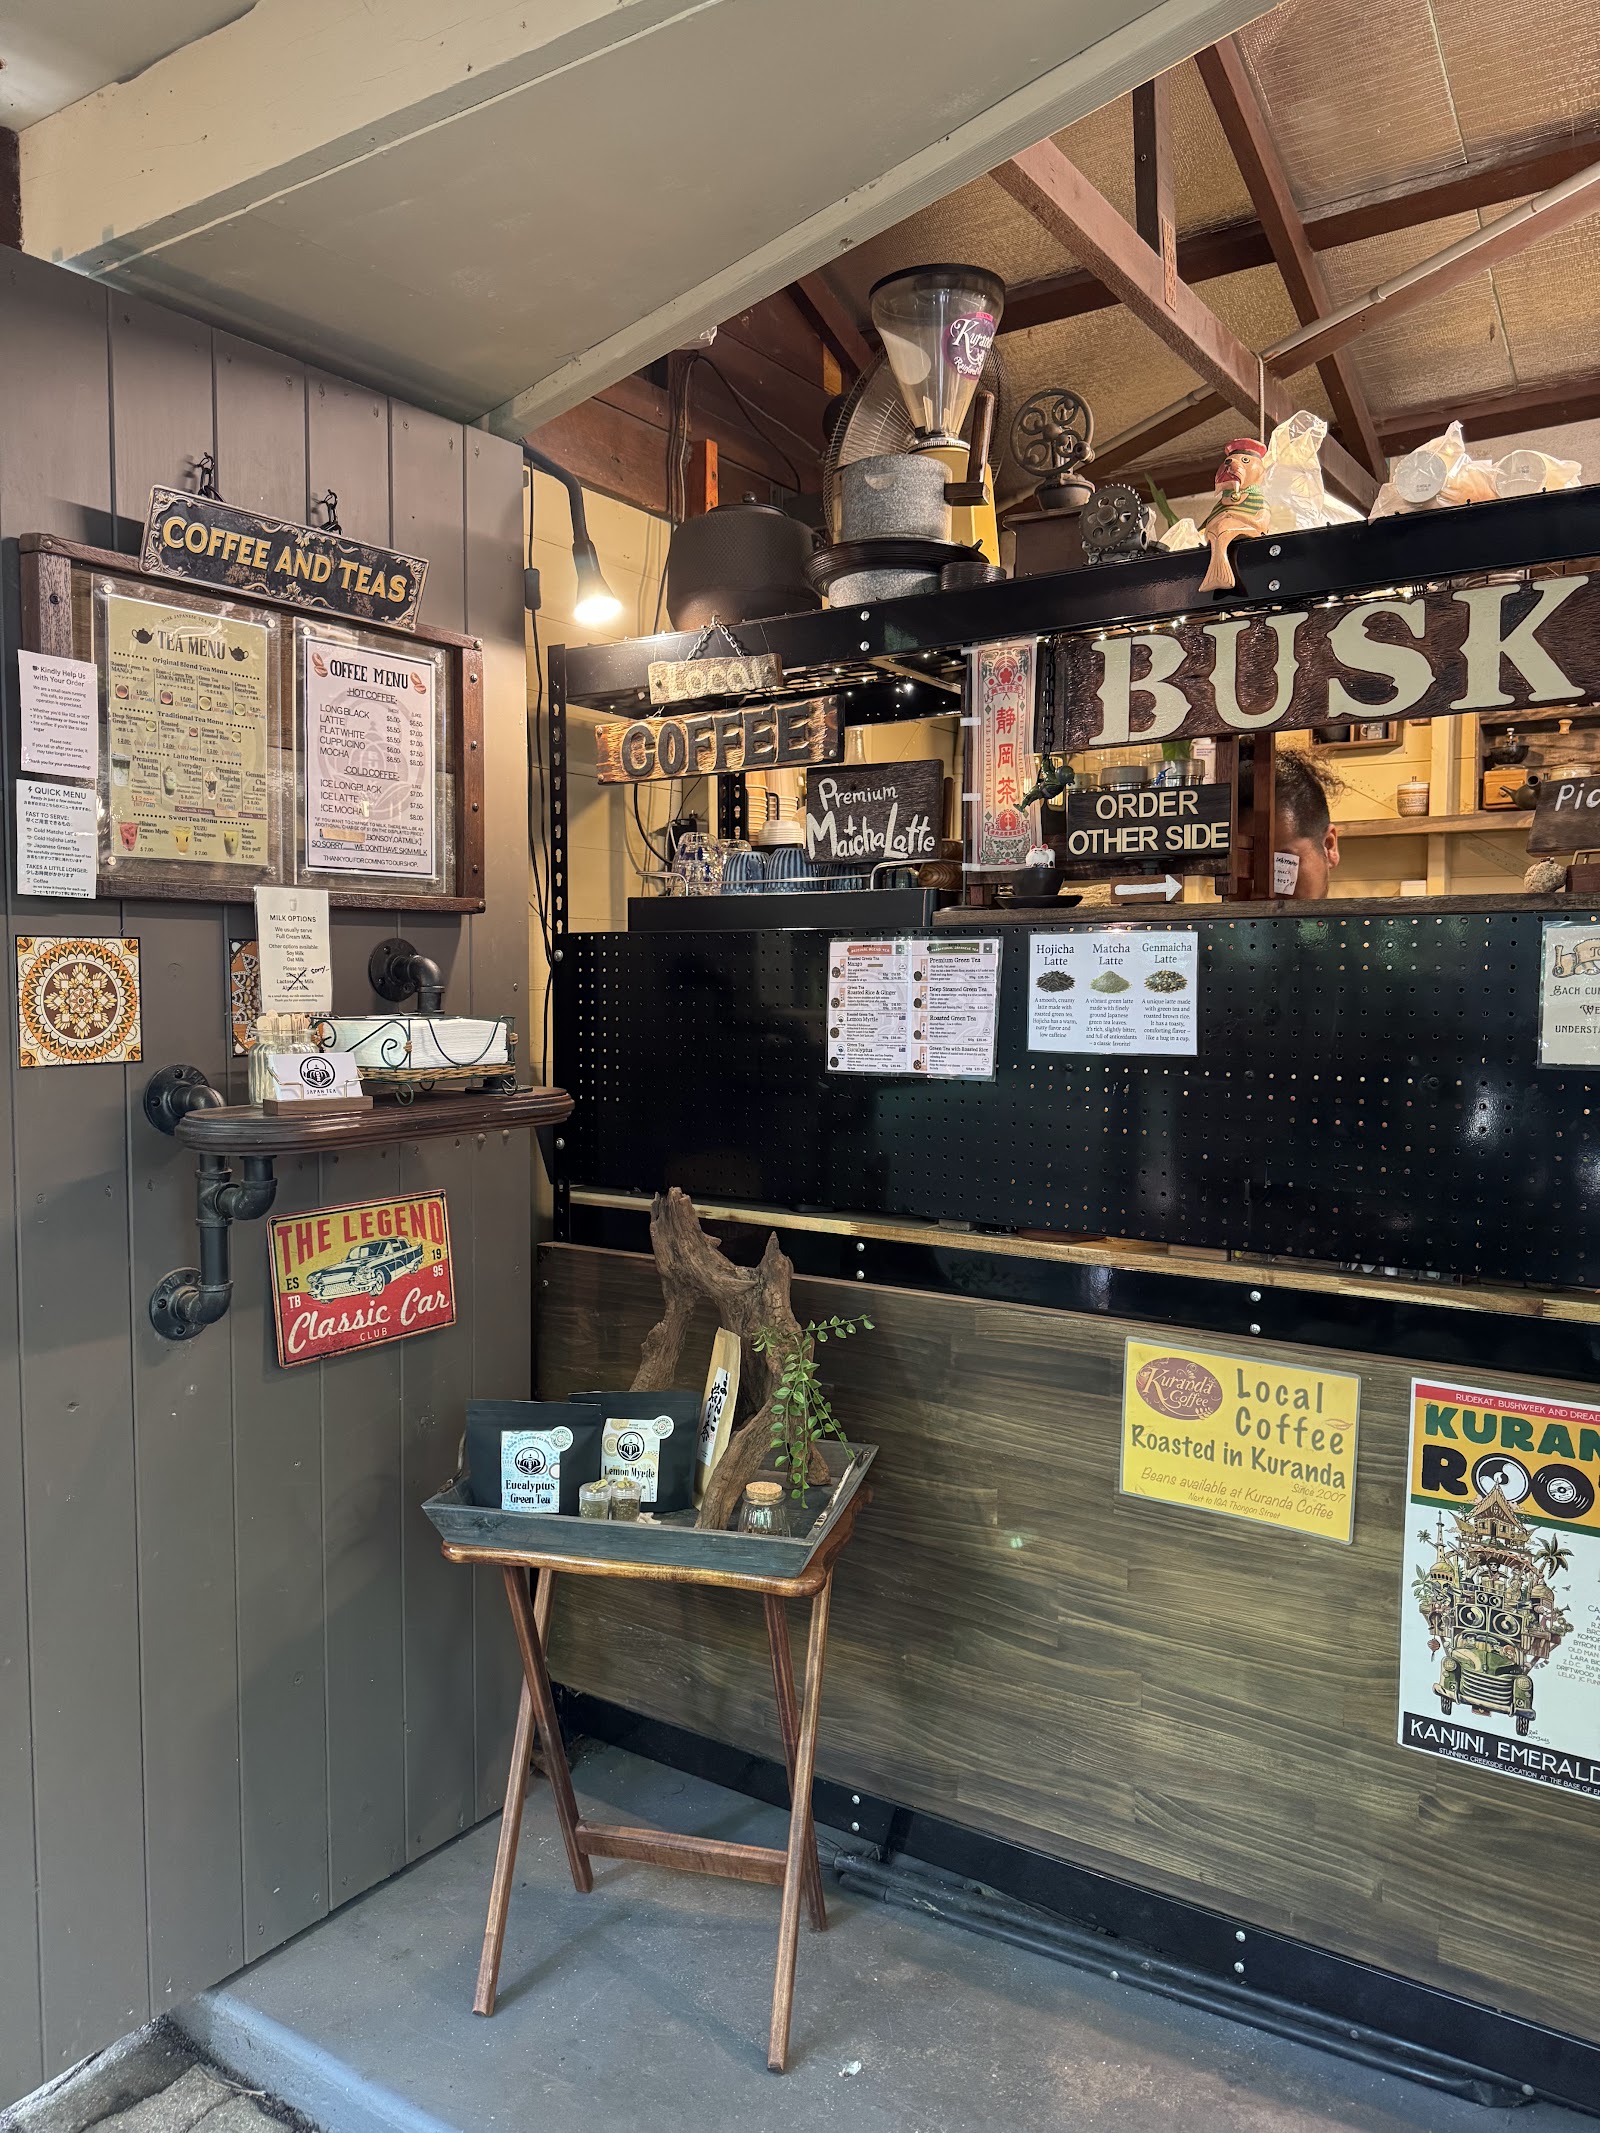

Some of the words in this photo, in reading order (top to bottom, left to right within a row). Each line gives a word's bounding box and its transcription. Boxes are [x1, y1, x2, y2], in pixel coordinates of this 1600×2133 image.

[162, 516, 271, 569] COFFEE
[274, 546, 332, 584] AND
[338, 557, 407, 603] TEAS
[158, 630, 184, 653] TEA
[188, 637, 226, 660] MENU
[152, 657, 179, 667] Original
[180, 662, 198, 670] Blend
[210, 667, 228, 675] Menu
[1089, 574, 1589, 747] BUSK
[40, 667, 61, 676] Kindly
[62, 670, 77, 678] Help
[330, 660, 367, 682] COFFEE
[373, 668, 408, 689] MENU
[34, 674, 49, 682] with
[66, 679, 84, 687] Order
[158, 711, 193, 722] Traditional
[320, 704, 343, 714] LONG
[344, 708, 370, 719] BLACK
[320, 715, 345, 725] LATTE
[320, 725, 341, 736] FLAT
[341, 728, 365, 740] WHITE
[320, 736, 366, 750] CUPPUCINO
[622, 703, 812, 777] COFFEE
[320, 747, 349, 758] MOCHA
[996, 706, 1016, 805] 静岡茶
[35, 787, 61, 796] QUICK
[63, 790, 86, 799] MENU
[321, 792, 334, 801] ICE
[335, 793, 359, 803] LATTE
[818, 777, 898, 811] Premium
[335, 806, 364, 815] MOCHA
[1096, 790, 1199, 820] ORDER
[1068, 825, 1158, 855] OTHER
[1165, 822, 1230, 850] SIDE
[1036, 944, 1075, 956] Hojicha
[1092, 944, 1130, 953] Matcha
[1142, 943, 1192, 952] Genmaicha
[1044, 956, 1068, 965] Latte
[1099, 956, 1123, 965] Latte
[1154, 955, 1177, 964] Latte
[277, 1219, 331, 1276] THE
[344, 1201, 444, 1246] LEGEND
[432, 1249, 442, 1260] 19
[433, 1265, 443, 1276] 95
[286, 1277, 300, 1290] ES
[288, 1295, 301, 1308] TB
[288, 1300, 391, 1354] Classic
[400, 1287, 449, 1326] Car
[360, 1327, 388, 1341] CLUB
[1143, 1367, 1214, 1402] Kuranda
[1236, 1368, 1324, 1413] Local
[1169, 1390, 1208, 1408] Coffee
[1498, 1401, 1545, 1414] BUSHWEEK
[1549, 1408, 1568, 1417] AND
[1235, 1406, 1344, 1455] Coffee
[1131, 1424, 1215, 1462] Roasted
[1223, 1442, 1242, 1466] in
[1251, 1446, 1346, 1489] Kuranda
[605, 1466, 629, 1475] Lemon
[631, 1467, 655, 1479] Myrtle
[506, 1480, 555, 1493] Eucalyptus
[1141, 1467, 1177, 1486] Beans
[1179, 1477, 1227, 1495] available
[1230, 1487, 1243, 1498] at
[1245, 1488, 1293, 1510] Kuranda
[1296, 1500, 1334, 1520] Coffee
[511, 1493, 534, 1503] Green
[536, 1494, 550, 1504] Tea
[1291, 1484, 1315, 1497] Since
[1317, 1488, 1346, 1504] 2007
[1188, 1492, 1204, 1503] Next
[1206, 1496, 1213, 1504] to
[1229, 1502, 1258, 1516] Thongon
[1259, 1508, 1281, 1519] Street
[1570, 1655, 1589, 1663] LARA
[1556, 1665, 1594, 1677] DRIFTWOOD
[1439, 1748, 1469, 1760] STUNNING
[1470, 1756, 1503, 1769] CREEKSIDE
[1505, 1765, 1537, 1779] LOCATION
[1550, 1778, 1562, 1786] THE
[1563, 1781, 1580, 1791] BASE
[1582, 1785, 1592, 1793] OF
